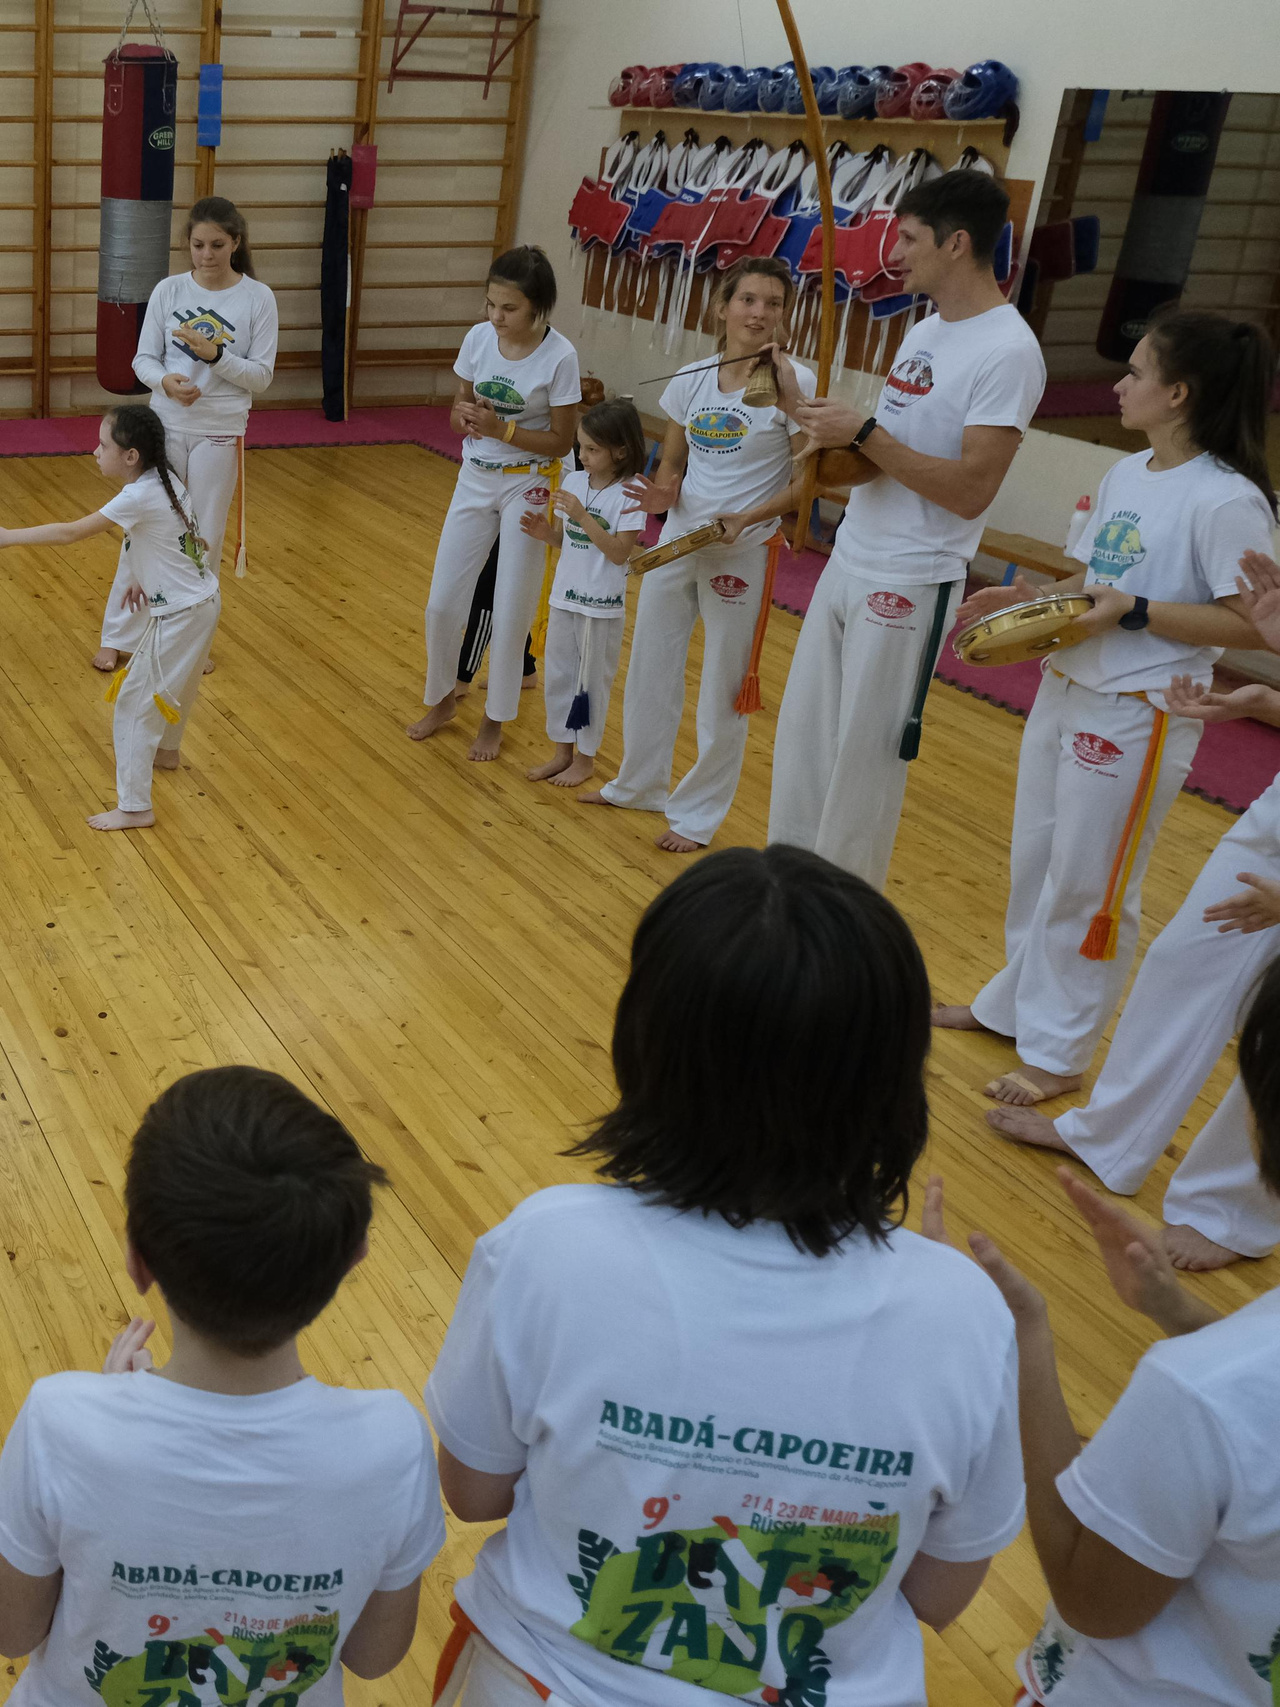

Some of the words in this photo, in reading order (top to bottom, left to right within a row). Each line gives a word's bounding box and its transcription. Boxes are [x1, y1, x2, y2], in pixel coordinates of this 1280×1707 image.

[491, 374, 516, 387] SAMARA
[600, 1400, 914, 1477] ABADÁ-CAPOEIRA
[598, 1429, 646, 1450] Associação
[648, 1442, 690, 1459] Brasileira
[692, 1450, 704, 1459] de
[706, 1452, 734, 1465] Apoio
[744, 1457, 827, 1480] Desenvolvimento
[829, 1473, 841, 1482] da
[844, 1475, 908, 1489] Arte-Capoeira
[693, 1462, 725, 1475] Mestre
[726, 1467, 760, 1479] Camisa
[742, 1494, 762, 1509] 21
[763, 1497, 774, 1514] A
[777, 1502, 798, 1519] 23
[799, 1505, 819, 1521] DE
[821, 1508, 859, 1526] MAIO
[821, 1525, 891, 1546] SAMARA
[111, 1561, 344, 1593] ABADÁ-CAPOEIRA
[224, 1611, 238, 1623] 21
[240, 1615, 247, 1626] A
[250, 1618, 265, 1631] 23
[267, 1618, 280, 1631] DE
